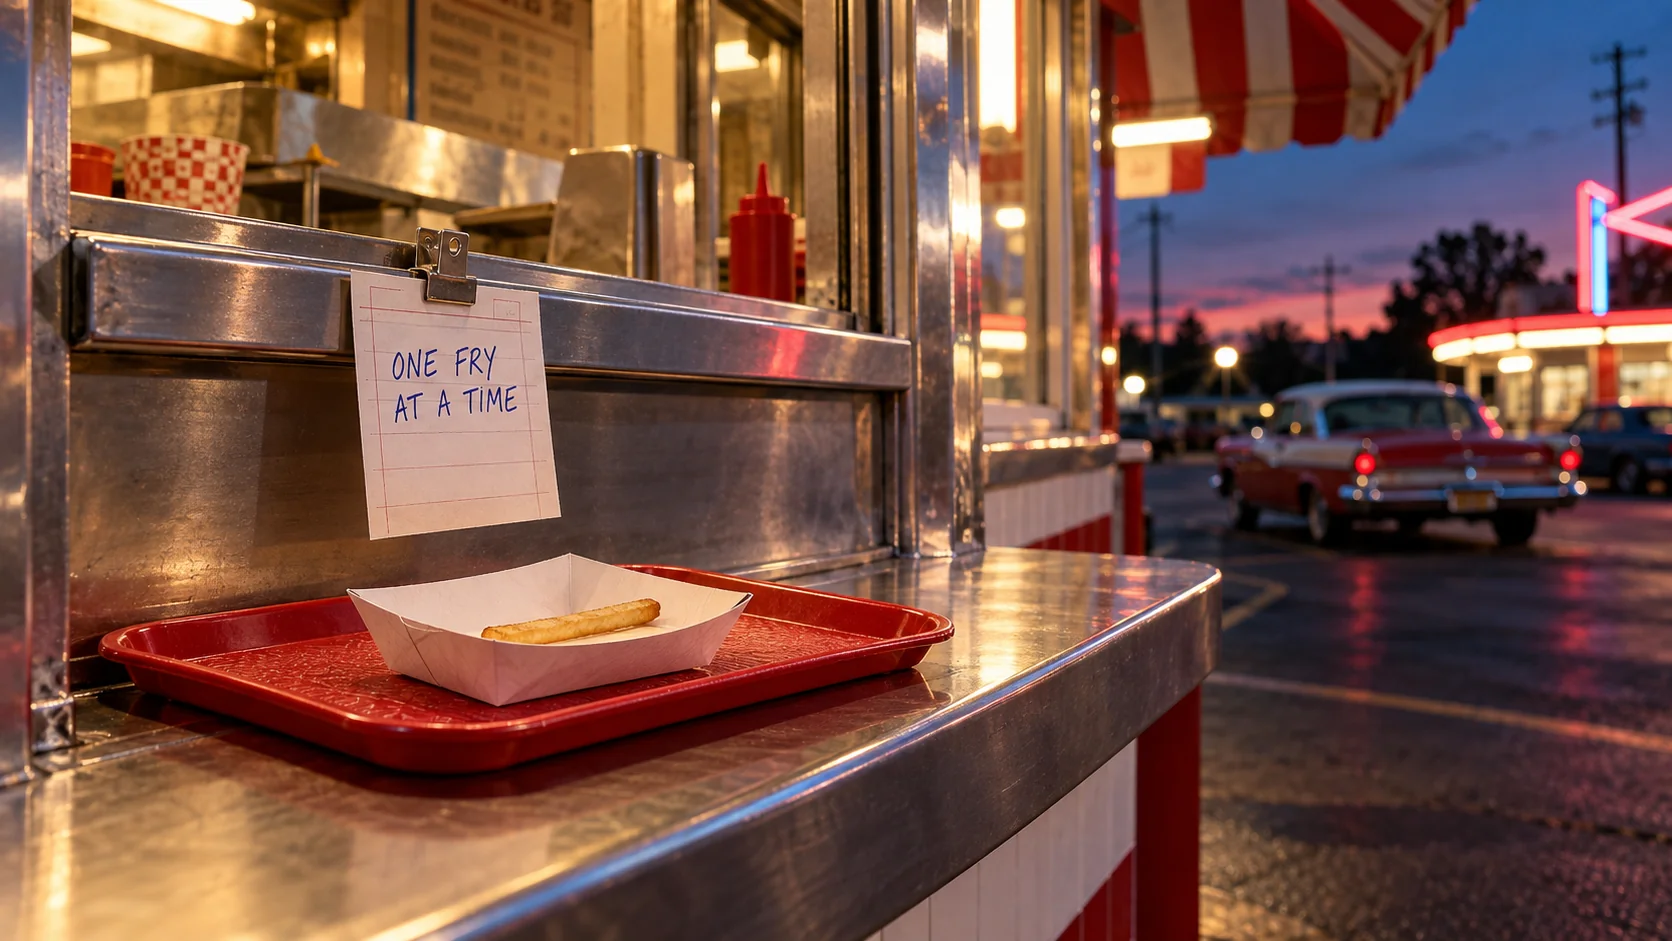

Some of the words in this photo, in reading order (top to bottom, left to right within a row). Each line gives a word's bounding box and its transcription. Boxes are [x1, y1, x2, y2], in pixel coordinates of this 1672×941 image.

[392, 349, 438, 381] ONE
[455, 346, 497, 381] FRY
[394, 392, 424, 423] AT
[437, 389, 451, 417] A
